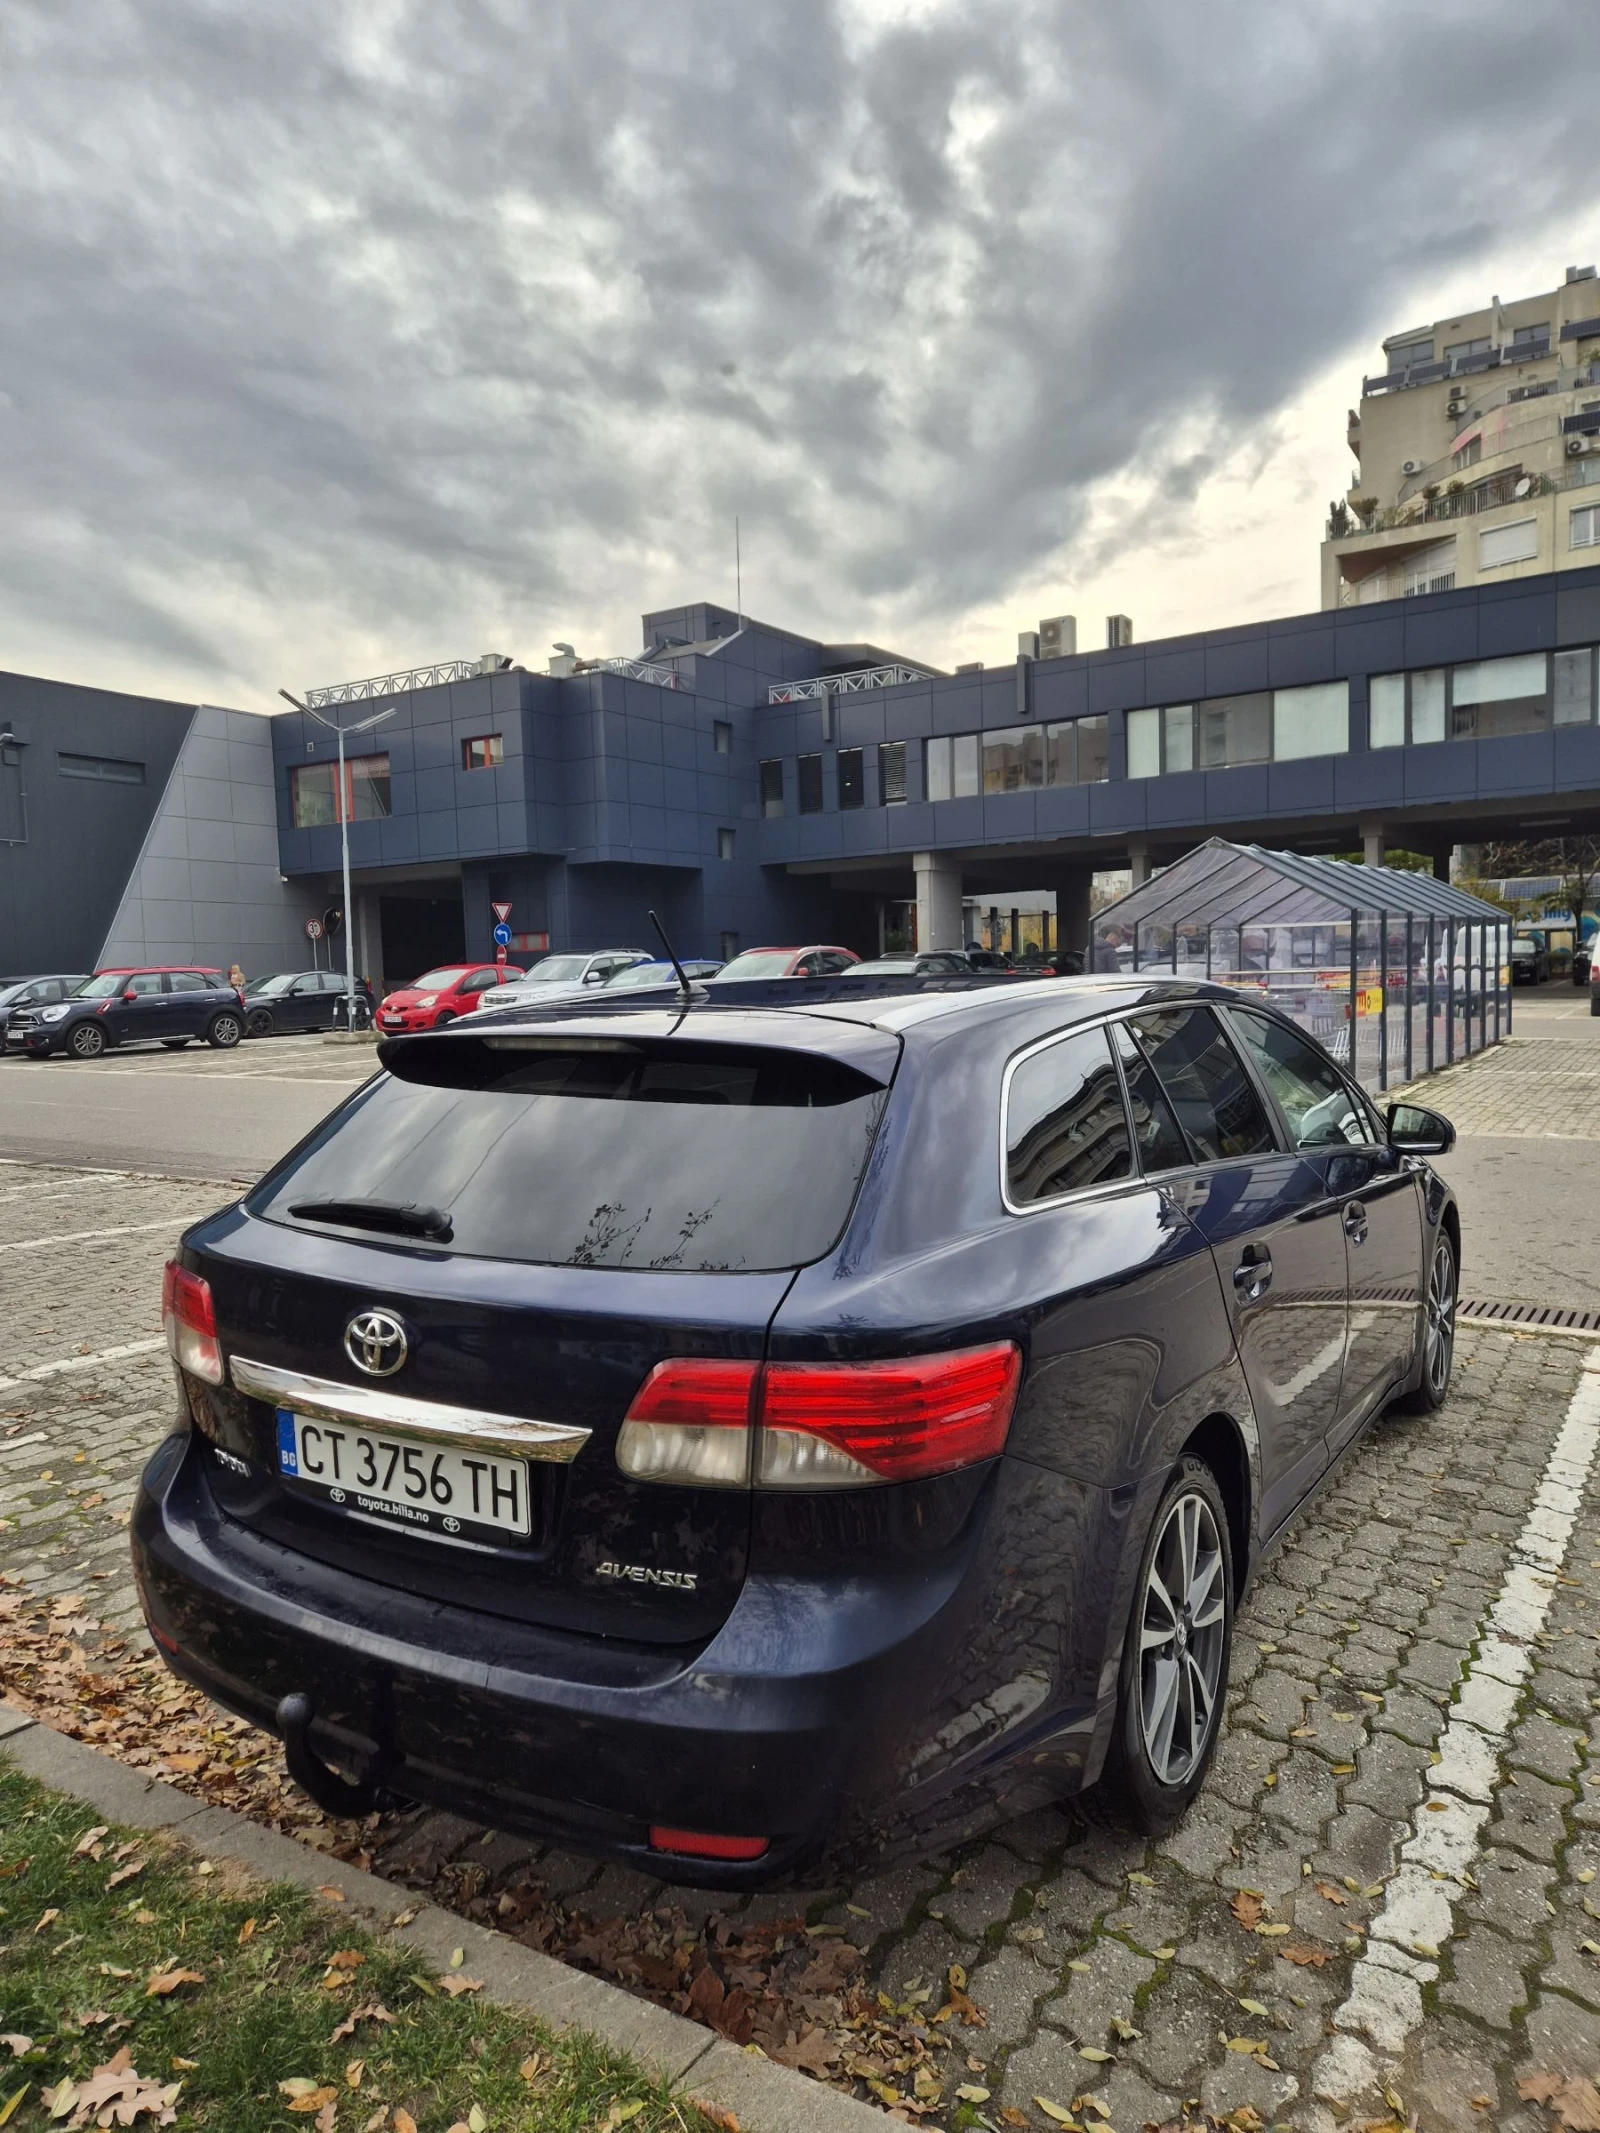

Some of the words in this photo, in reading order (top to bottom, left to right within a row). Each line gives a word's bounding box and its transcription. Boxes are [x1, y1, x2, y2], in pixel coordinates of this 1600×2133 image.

[281, 1451, 297, 1467] BG
[301, 1425, 345, 1479] CT
[356, 1437, 452, 1505] 3756
[461, 1459, 518, 1522] TH
[357, 1494, 429, 1523] toyota.bilia.no
[596, 1562, 698, 1590] AVENSIS
